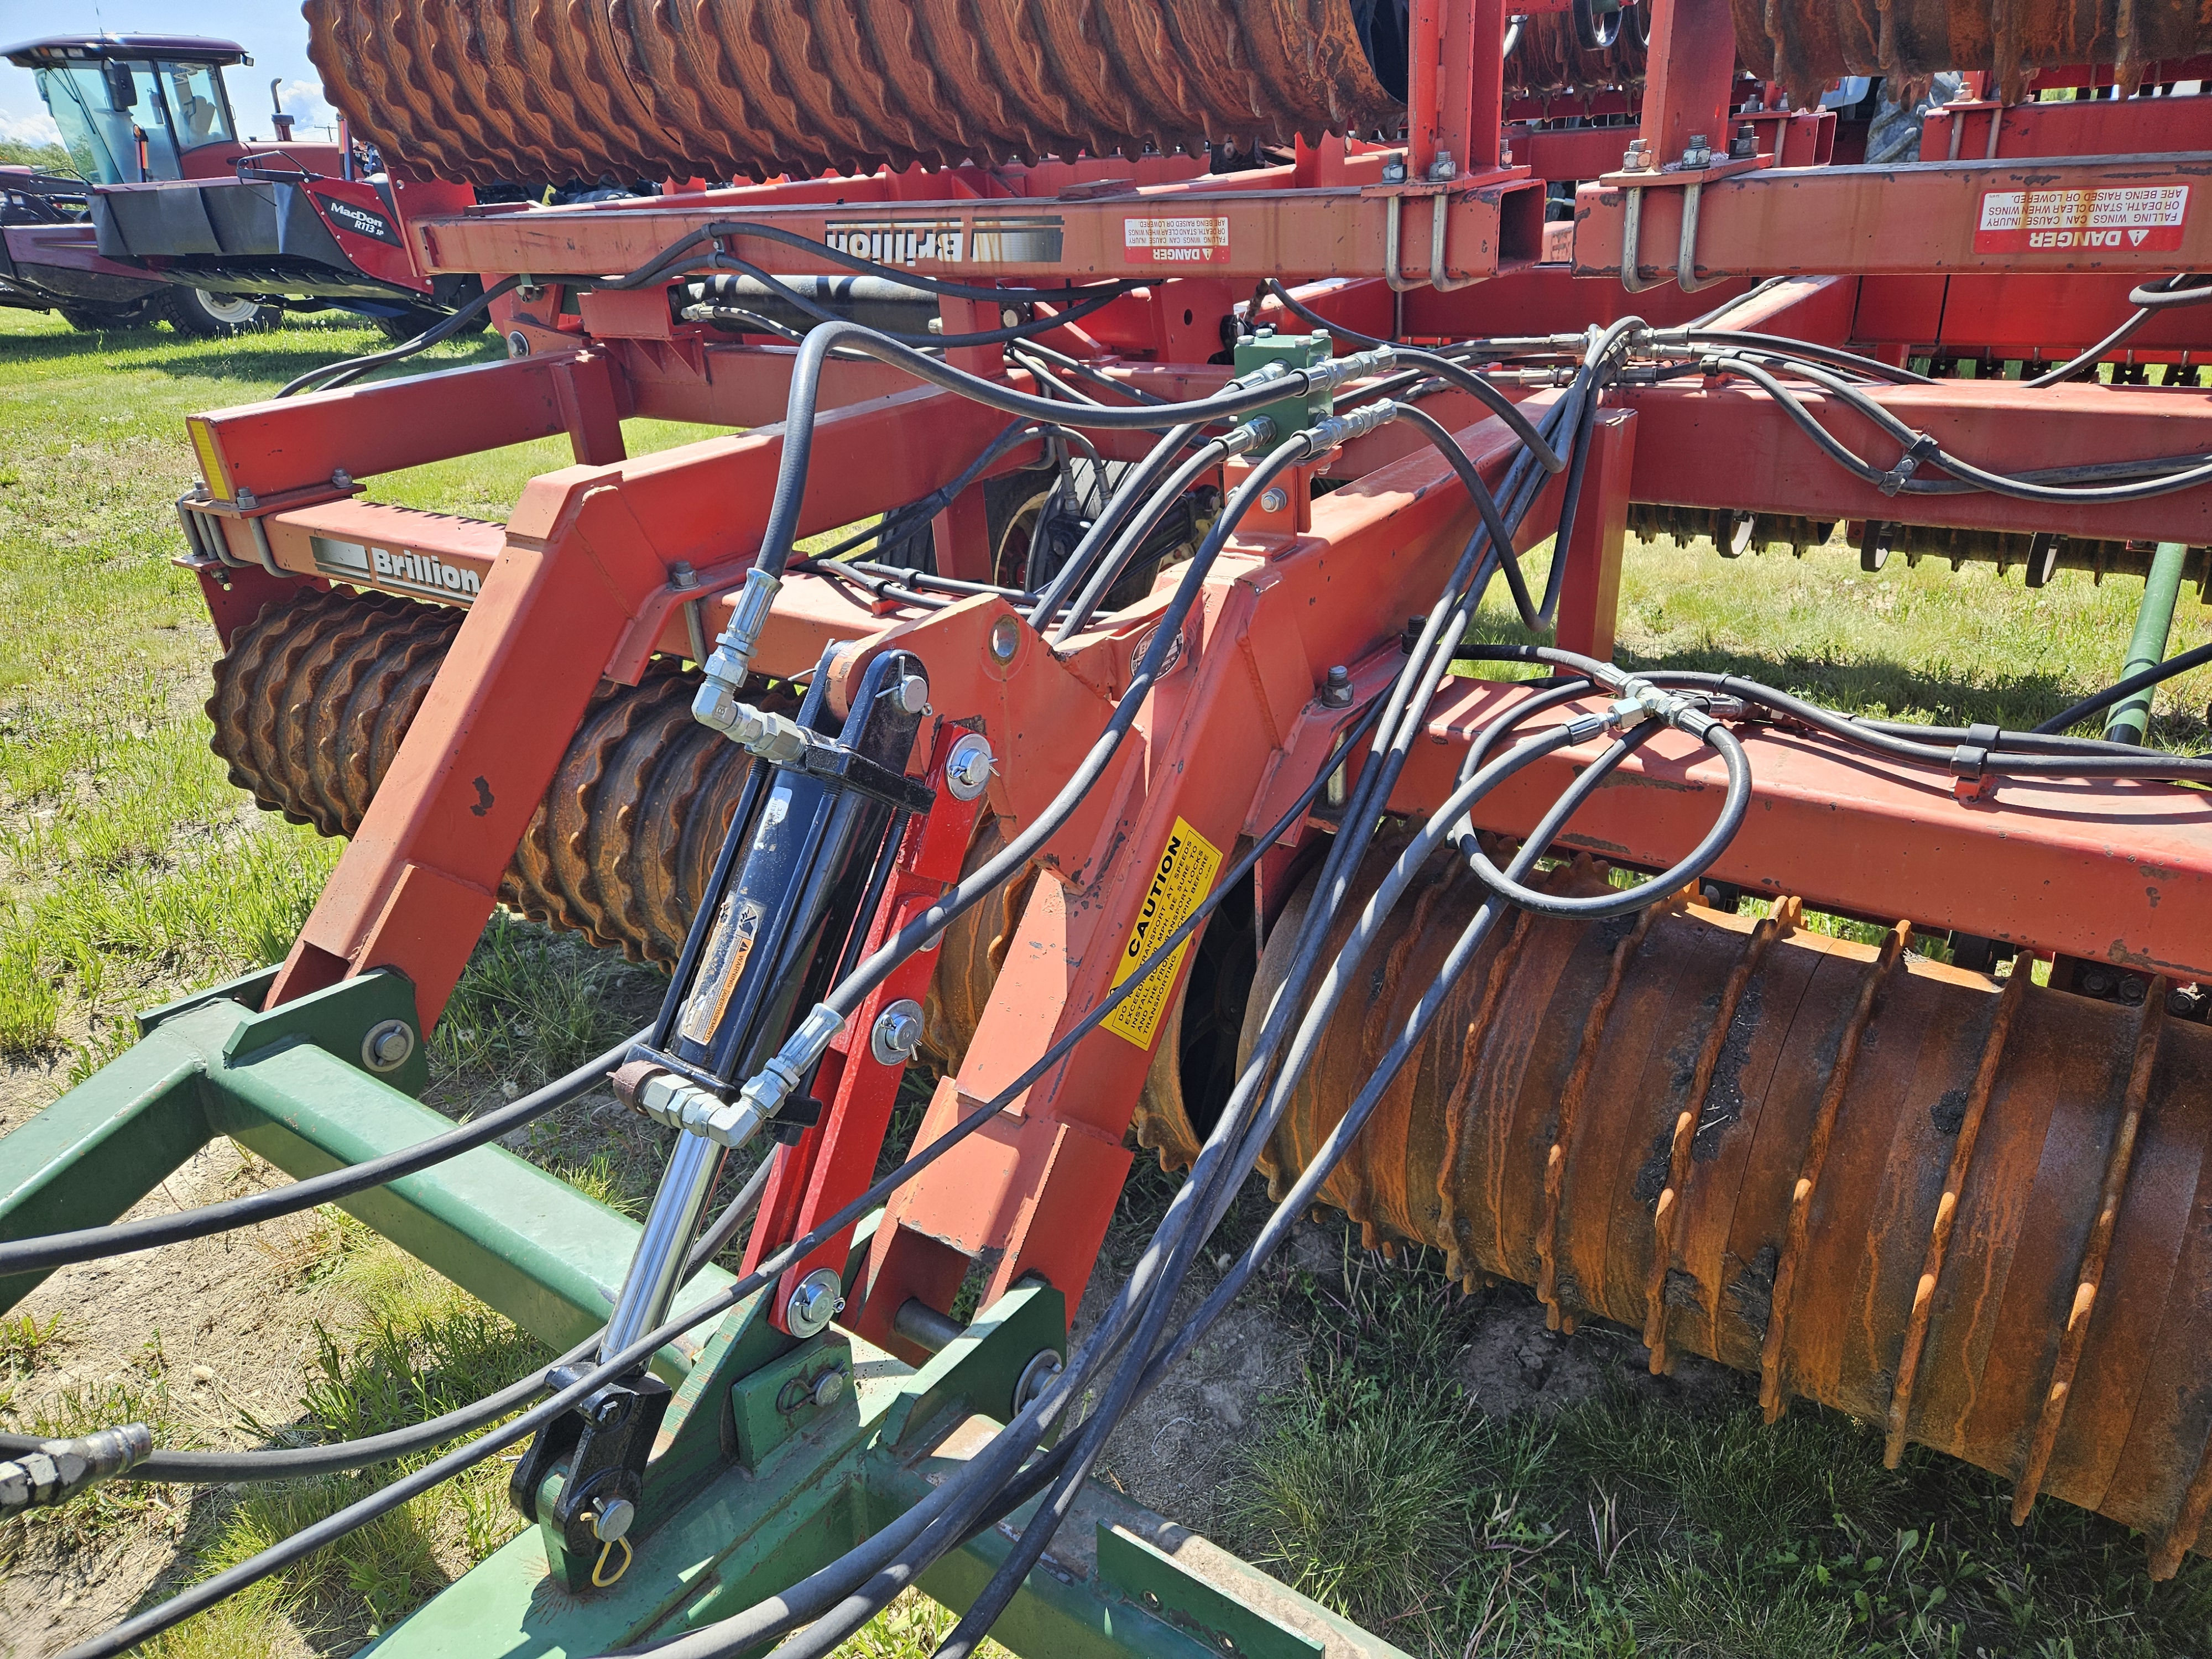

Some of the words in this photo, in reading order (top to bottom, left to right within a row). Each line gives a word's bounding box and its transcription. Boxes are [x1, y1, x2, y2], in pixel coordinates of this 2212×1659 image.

[2065, 193, 2081, 202] OR
[2083, 191, 2122, 201] RAISED
[2124, 190, 2157, 200] BEING
[2160, 189, 2183, 198] ARE
[2010, 194, 2063, 204] LOWERED.
[2021, 205, 2051, 215] WHEN
[2052, 204, 2084, 213] CLEAR
[2088, 202, 2122, 212] STAND
[2124, 201, 2162, 211] DEATH.
[2163, 200, 2180, 210] OR
[331, 202, 383, 227] MacDon
[1987, 206, 2020, 215] WINGS
[1986, 217, 2021, 226] INJURY
[2026, 215, 2060, 225] CAUSE
[2065, 215, 2087, 224] CAN
[2092, 213, 2127, 223] WINGS
[2132, 212, 2177, 222] FALLING
[354, 220, 375, 233] R113
[2028, 230, 2122, 247] DANGER
[827, 233, 963, 267] Brillion
[1152, 248, 1199, 260] DANGER
[371, 547, 480, 593] Brillion
[1129, 836, 1181, 957] CAUTION
[1157, 917, 1170, 941] MPH.
[1170, 897, 1177, 910] BE
[1177, 864, 1190, 891] SURE
[1190, 846, 1197, 858] TO
[1119, 1006, 1126, 1021] DO
[1139, 904, 1166, 968] TRANSPORT
[1167, 885, 1173, 900] AT
[1175, 841, 1191, 879] SPEEDS
[1131, 987, 1150, 1028] INSTALL
[1164, 886, 1189, 943] RANSPORT
[1188, 851, 1203, 884] LOCKS
[1138, 1010, 1147, 1032] AND
[1147, 985, 1157, 1004] THE
[1191, 854, 1208, 894] BEFORE
[727, 955, 744, 987] WARNING
[1143, 954, 1177, 1034] TRANSPORTING.
[705, 989, 727, 1040] (AVERTISSEMENT)
